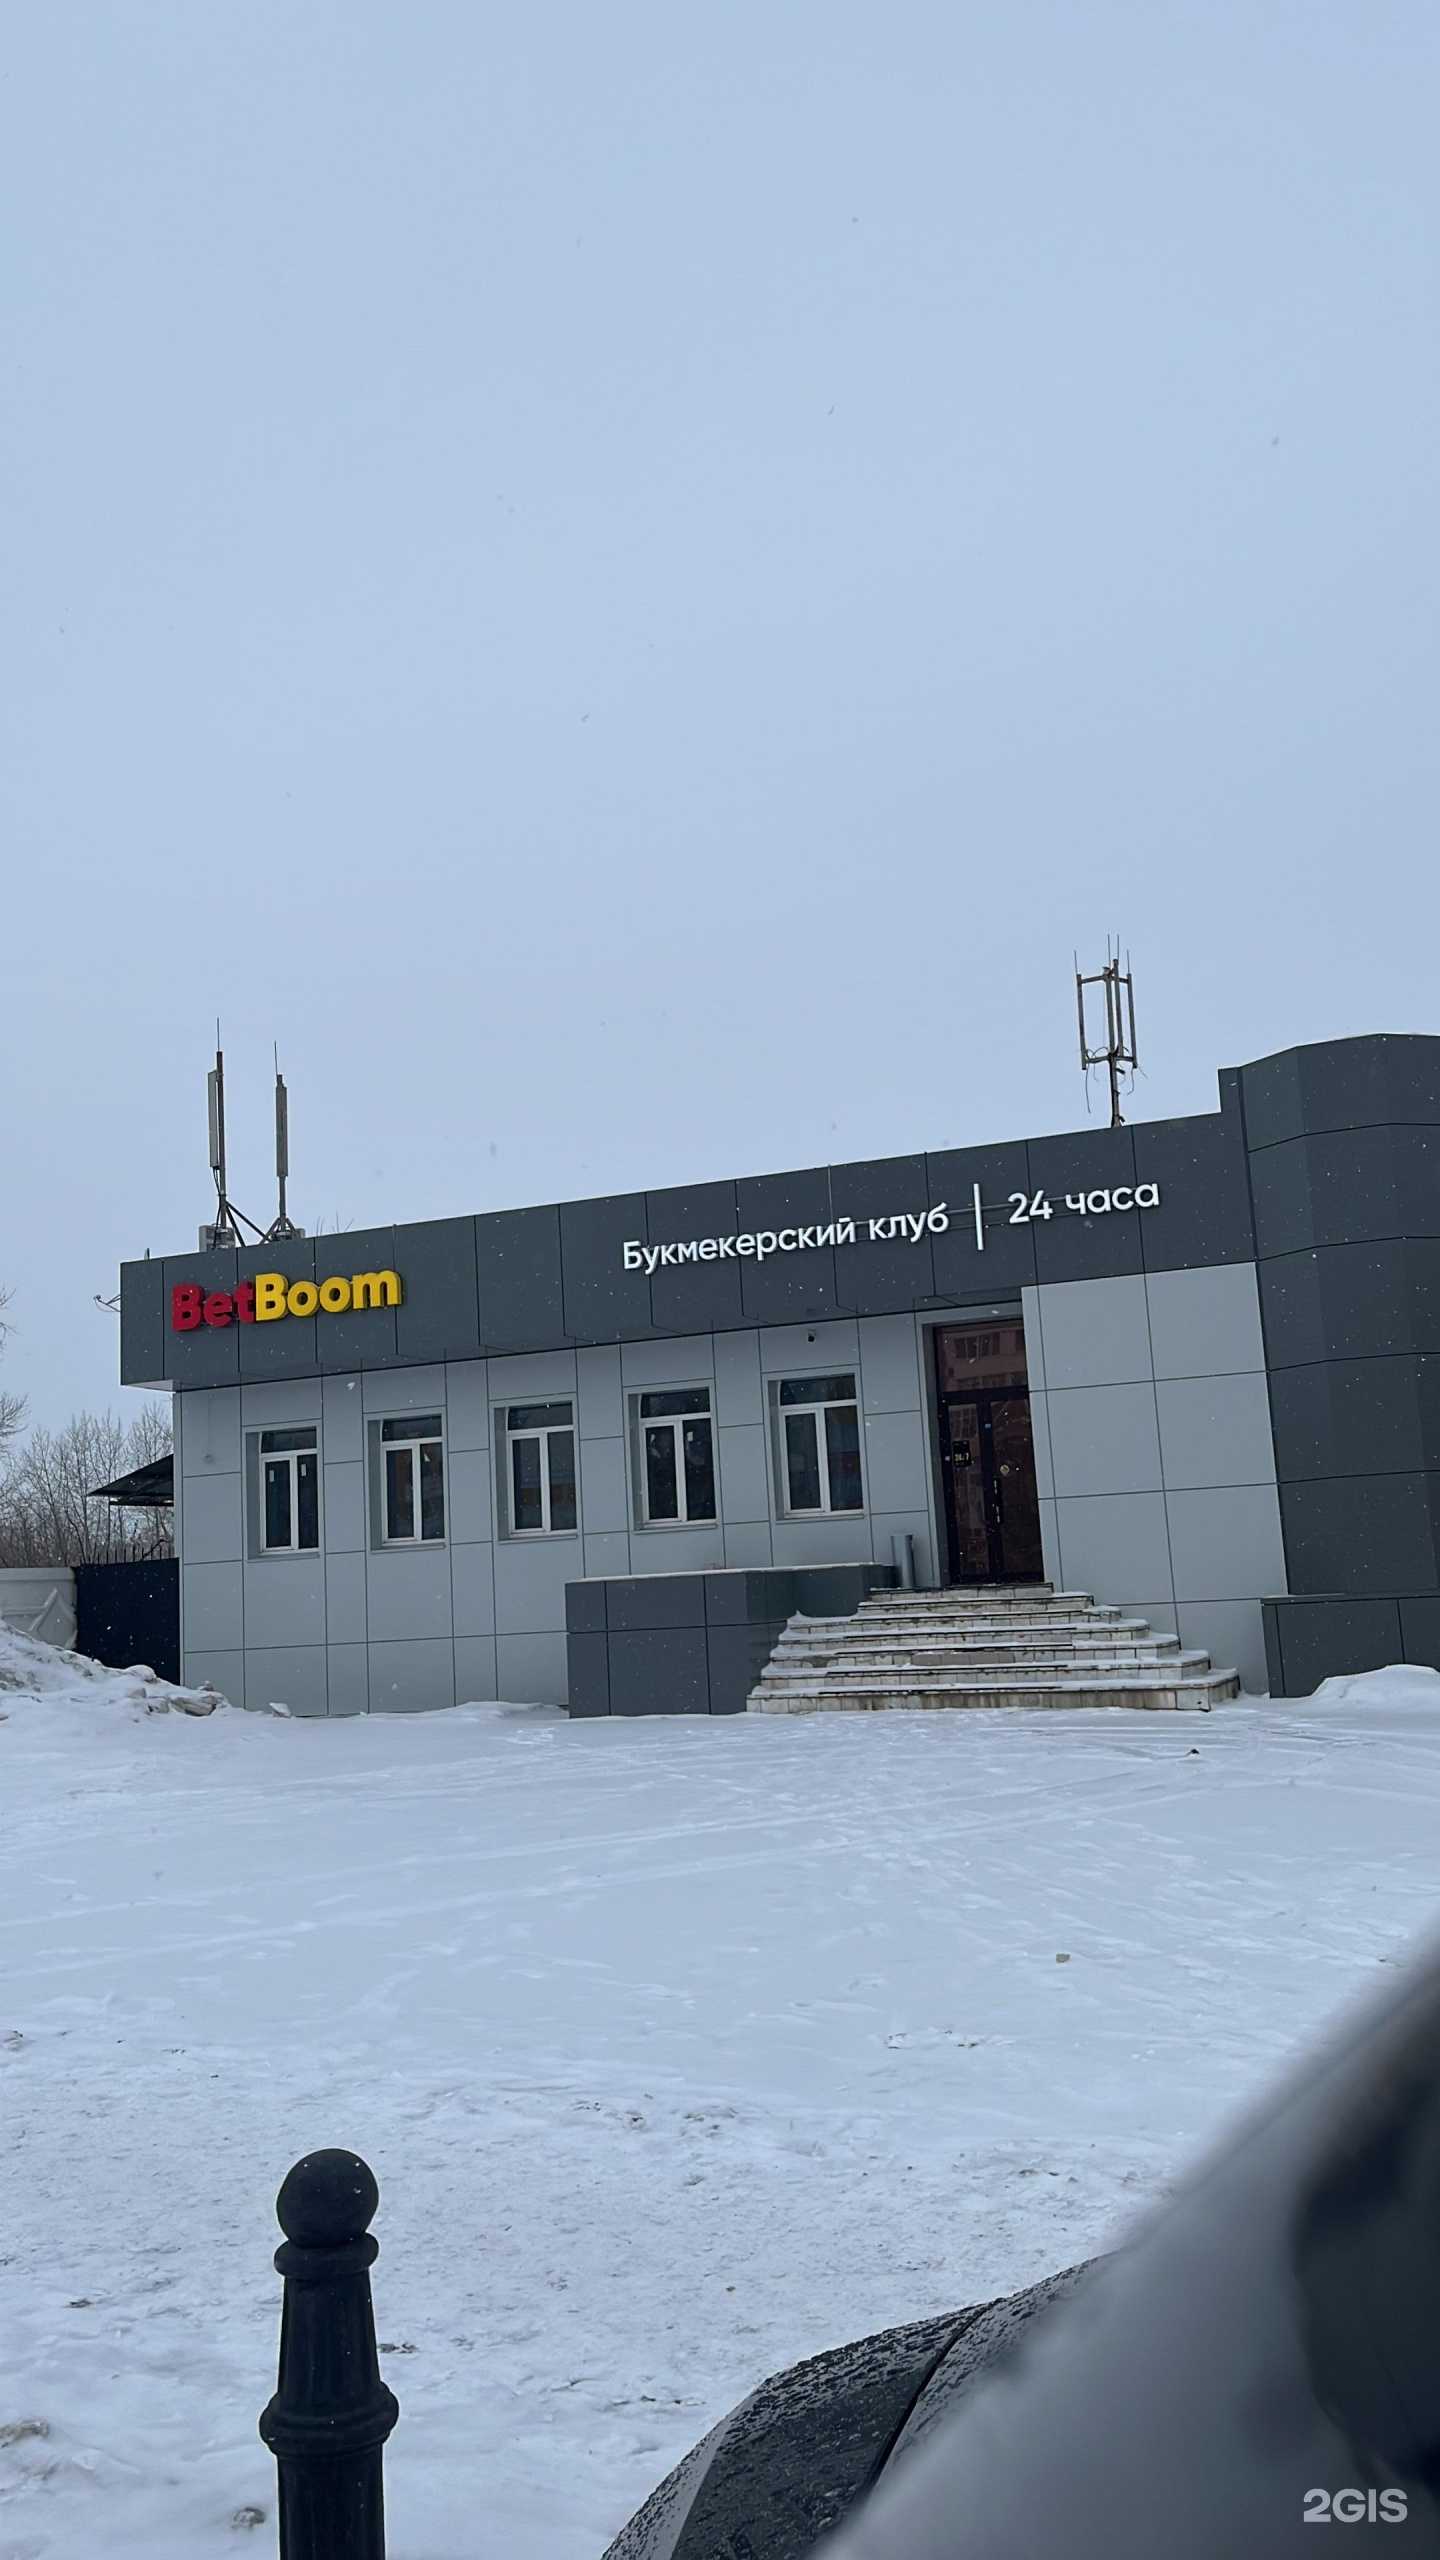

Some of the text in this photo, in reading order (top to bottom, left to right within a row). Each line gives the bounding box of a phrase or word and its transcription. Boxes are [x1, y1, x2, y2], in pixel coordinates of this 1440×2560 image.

[623, 1180, 1161, 1275] Букмекерский клуб 24 часа
[172, 1270, 402, 1332] BetBoom
